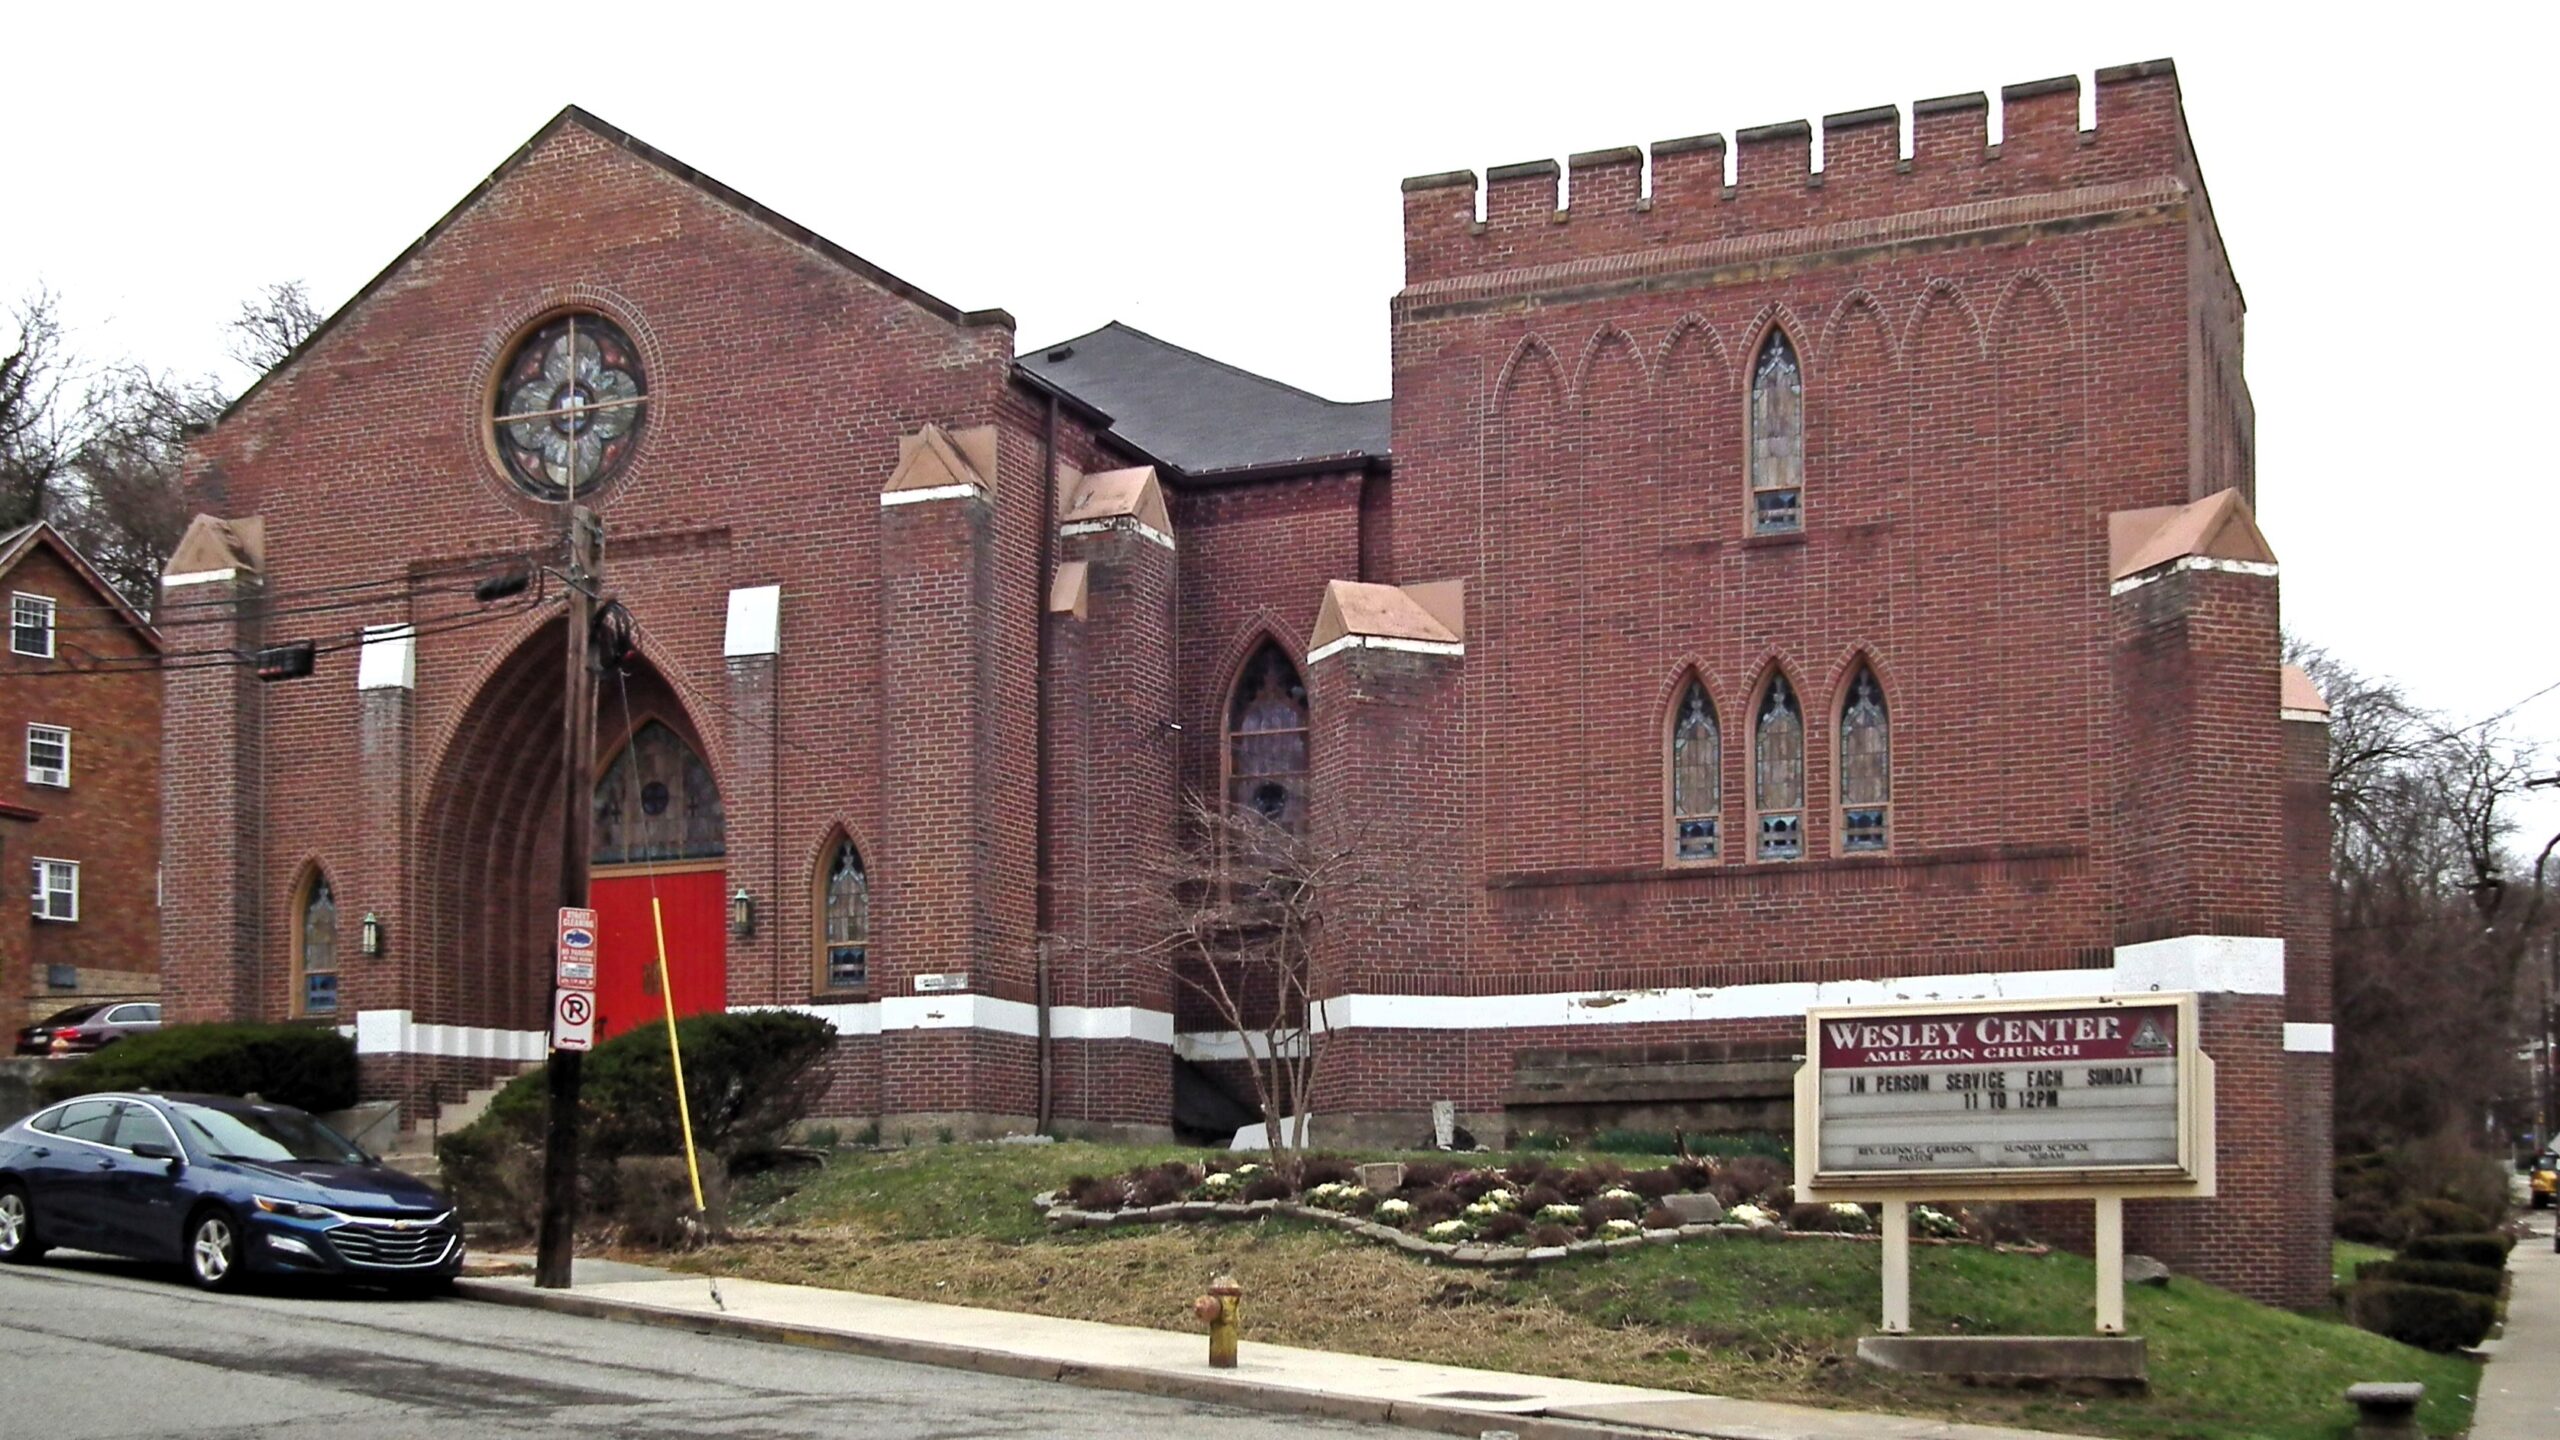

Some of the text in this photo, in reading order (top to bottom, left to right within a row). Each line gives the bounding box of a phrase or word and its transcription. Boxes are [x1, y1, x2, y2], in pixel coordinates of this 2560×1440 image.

[1825, 1016, 2123, 1050] WESLEY CENTER
[1865, 1044, 2080, 1062] AME ZION CHURCH
[1850, 1067, 2143, 1093] IN PERSON SERVICE EACH SUNDAY
[1964, 1090, 2059, 1110] 11 TO 12PM
